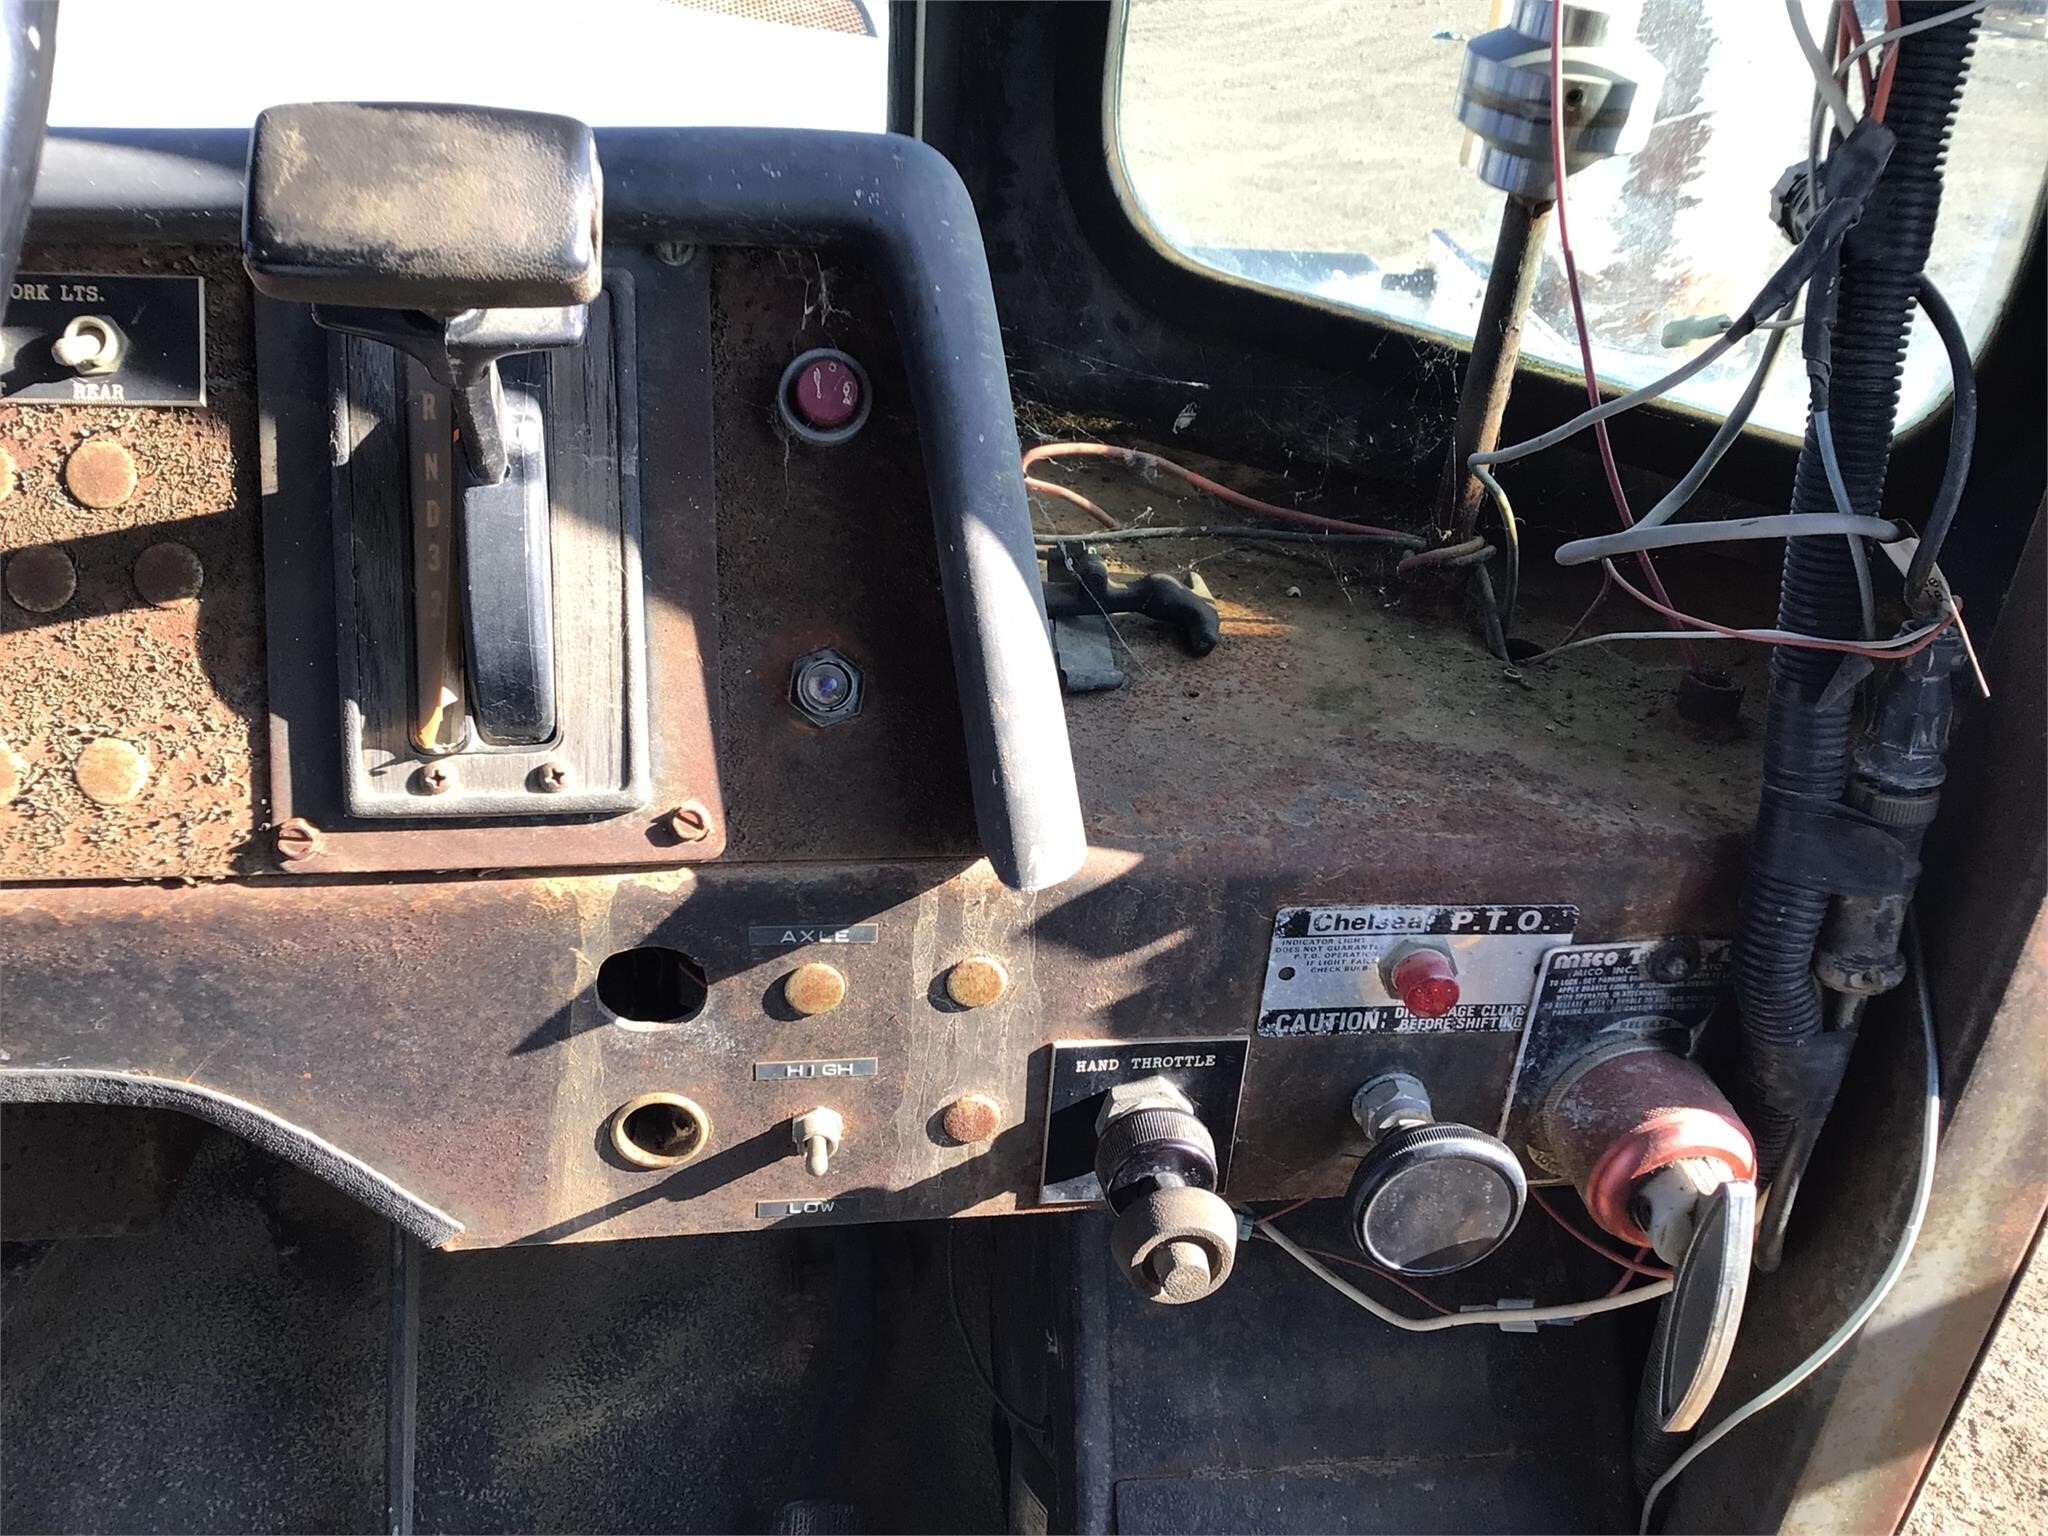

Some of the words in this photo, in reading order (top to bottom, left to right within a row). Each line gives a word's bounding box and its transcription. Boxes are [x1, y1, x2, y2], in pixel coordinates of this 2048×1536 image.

[10, 284, 50, 301] ORK
[60, 284, 105, 302] LTS.
[72, 382, 124, 400] REAR
[421, 391, 437, 420] R
[424, 453, 438, 480] N
[427, 500, 441, 528] D
[428, 544, 441, 571] 3
[1313, 912, 1423, 933] Chelsea
[1450, 910, 1550, 933] P.T.O.
[780, 929, 850, 943] AXLE
[1282, 938, 1334, 946] INDICATOR
[1338, 937, 1365, 945] LIGHT
[1275, 945, 1300, 953] DOES
[1303, 945, 1323, 953] NOT
[1310, 966, 1341, 974] CHECK
[1318, 958, 1346, 966] LIGHT
[1275, 1011, 1388, 1032] CAUTION:
[1399, 1017, 1453, 1030] BEFORE
[1456, 1016, 1523, 1029] SHIFTING
[787, 1063, 853, 1077] HIGH
[1075, 1059, 1119, 1072] HAND
[1131, 1055, 1216, 1069] THROTTLE
[789, 1201, 834, 1214] LOW
